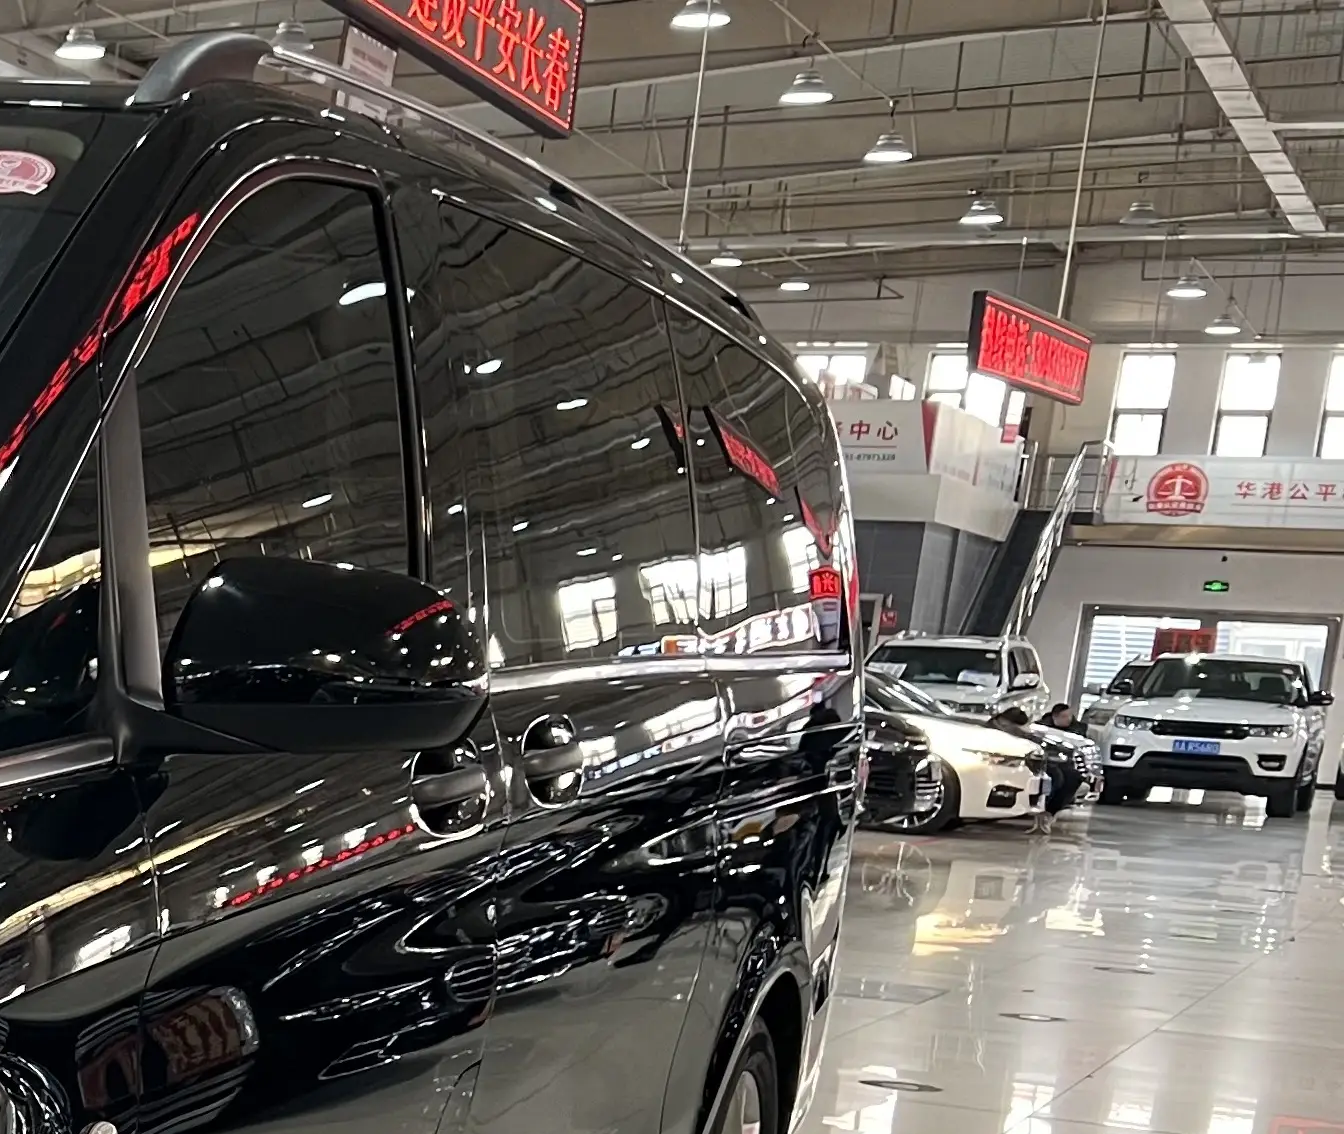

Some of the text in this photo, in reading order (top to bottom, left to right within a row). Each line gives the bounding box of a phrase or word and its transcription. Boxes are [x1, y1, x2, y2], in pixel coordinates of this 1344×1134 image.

[835, 420, 898, 441] 中心
[1235, 481, 1344, 501] 华港公平
